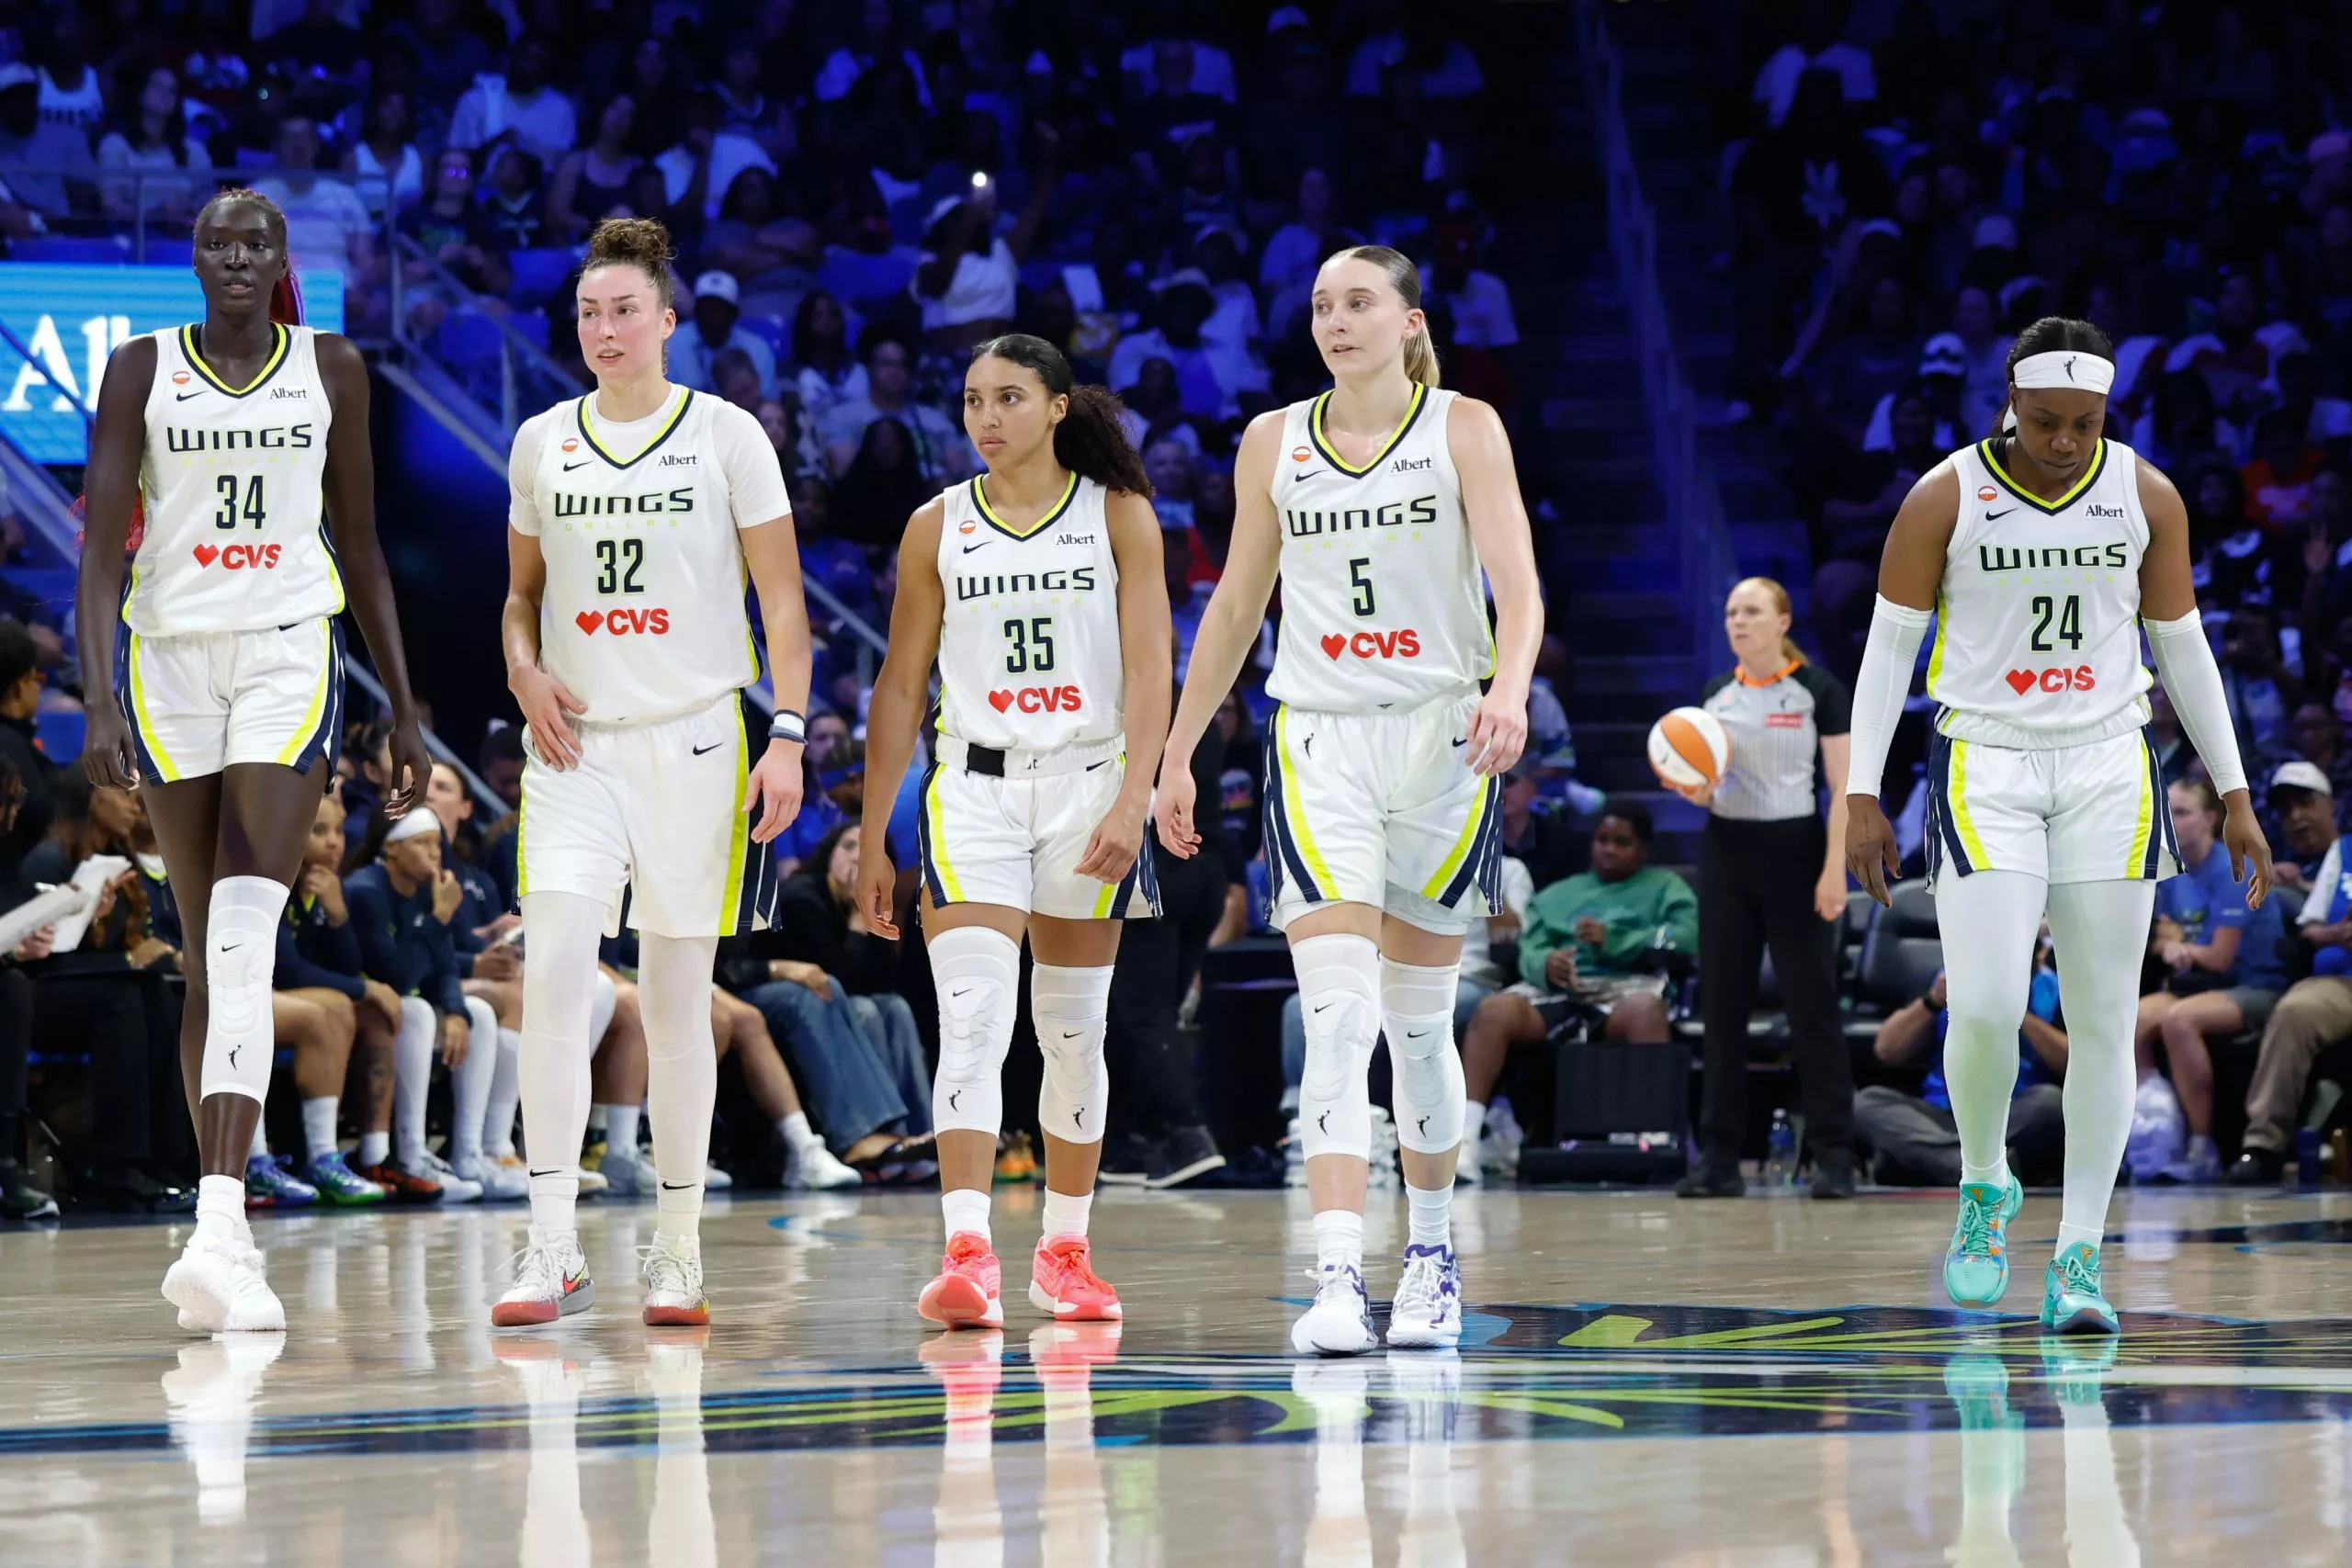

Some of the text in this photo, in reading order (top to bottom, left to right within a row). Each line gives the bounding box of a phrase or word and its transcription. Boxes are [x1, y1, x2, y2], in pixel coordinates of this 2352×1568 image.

[269, 386, 308, 400] Albert
[166, 423, 312, 453] WINGS
[658, 454, 697, 467] Albert
[1390, 457, 1432, 473] Albert
[215, 475, 266, 530] 34
[555, 487, 694, 517] WINGS
[1287, 495, 1436, 536] WINGS
[2085, 504, 2124, 518] Albert
[1056, 534, 1095, 545] Albert
[221, 544, 282, 570] CVS
[596, 538, 645, 593] 32
[1979, 542, 2127, 572] WINGS
[957, 567, 1095, 601] WINGS
[1349, 557, 1376, 616] 5
[606, 608, 670, 636] CVS
[2030, 594, 2084, 652] 24
[1003, 617, 1055, 673] 35
[1350, 629, 1420, 659] CVS
[1016, 685, 1082, 713] CVS
